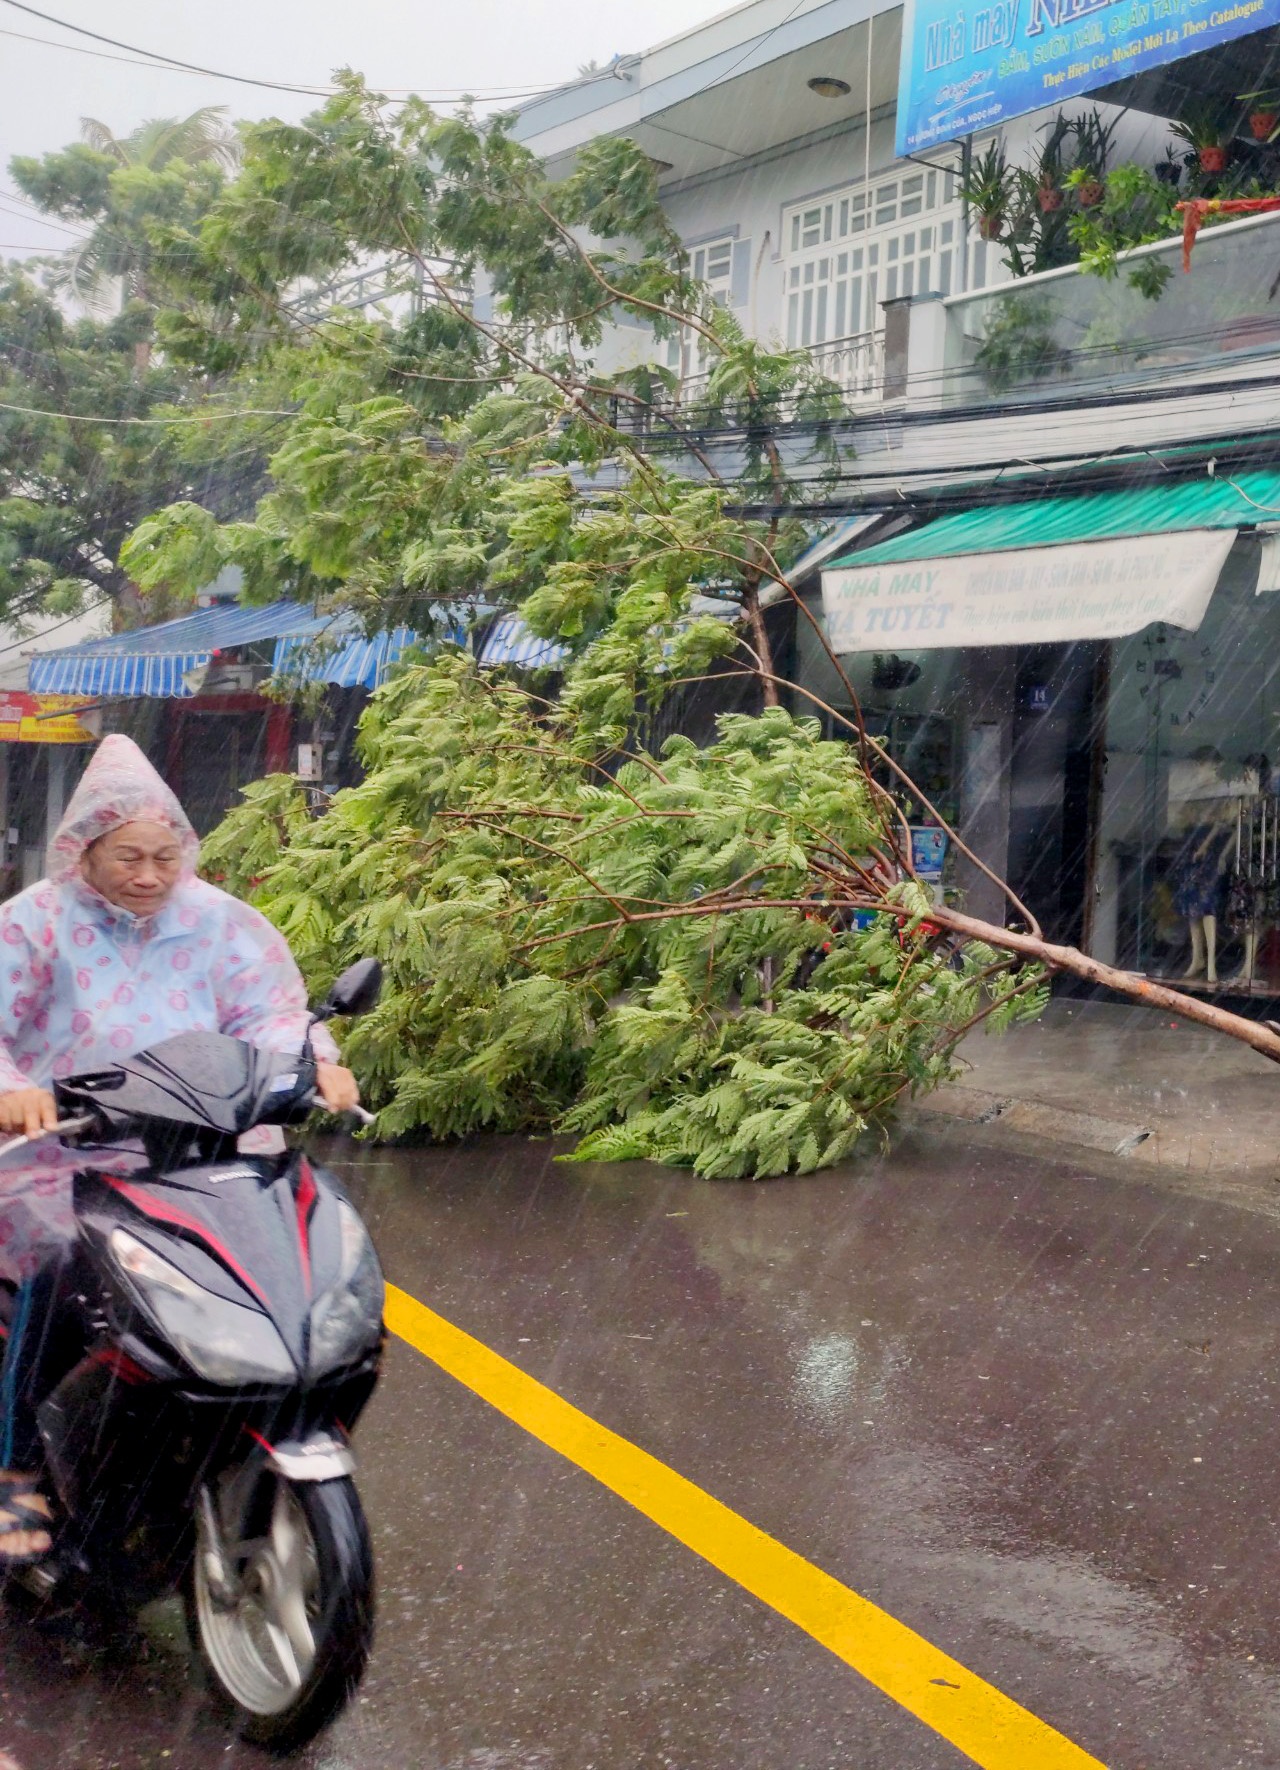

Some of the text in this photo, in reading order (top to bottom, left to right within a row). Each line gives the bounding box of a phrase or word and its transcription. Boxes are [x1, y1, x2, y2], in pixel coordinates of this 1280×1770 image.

[1183, 19, 1207, 38] Theo
[1210, 0, 1265, 27] Catalogue
[924, 10, 967, 72] Nhà
[838, 571, 880, 599] NHÀ
[888, 570, 940, 596] MAY
[864, 590, 954, 633] TUYẾT
